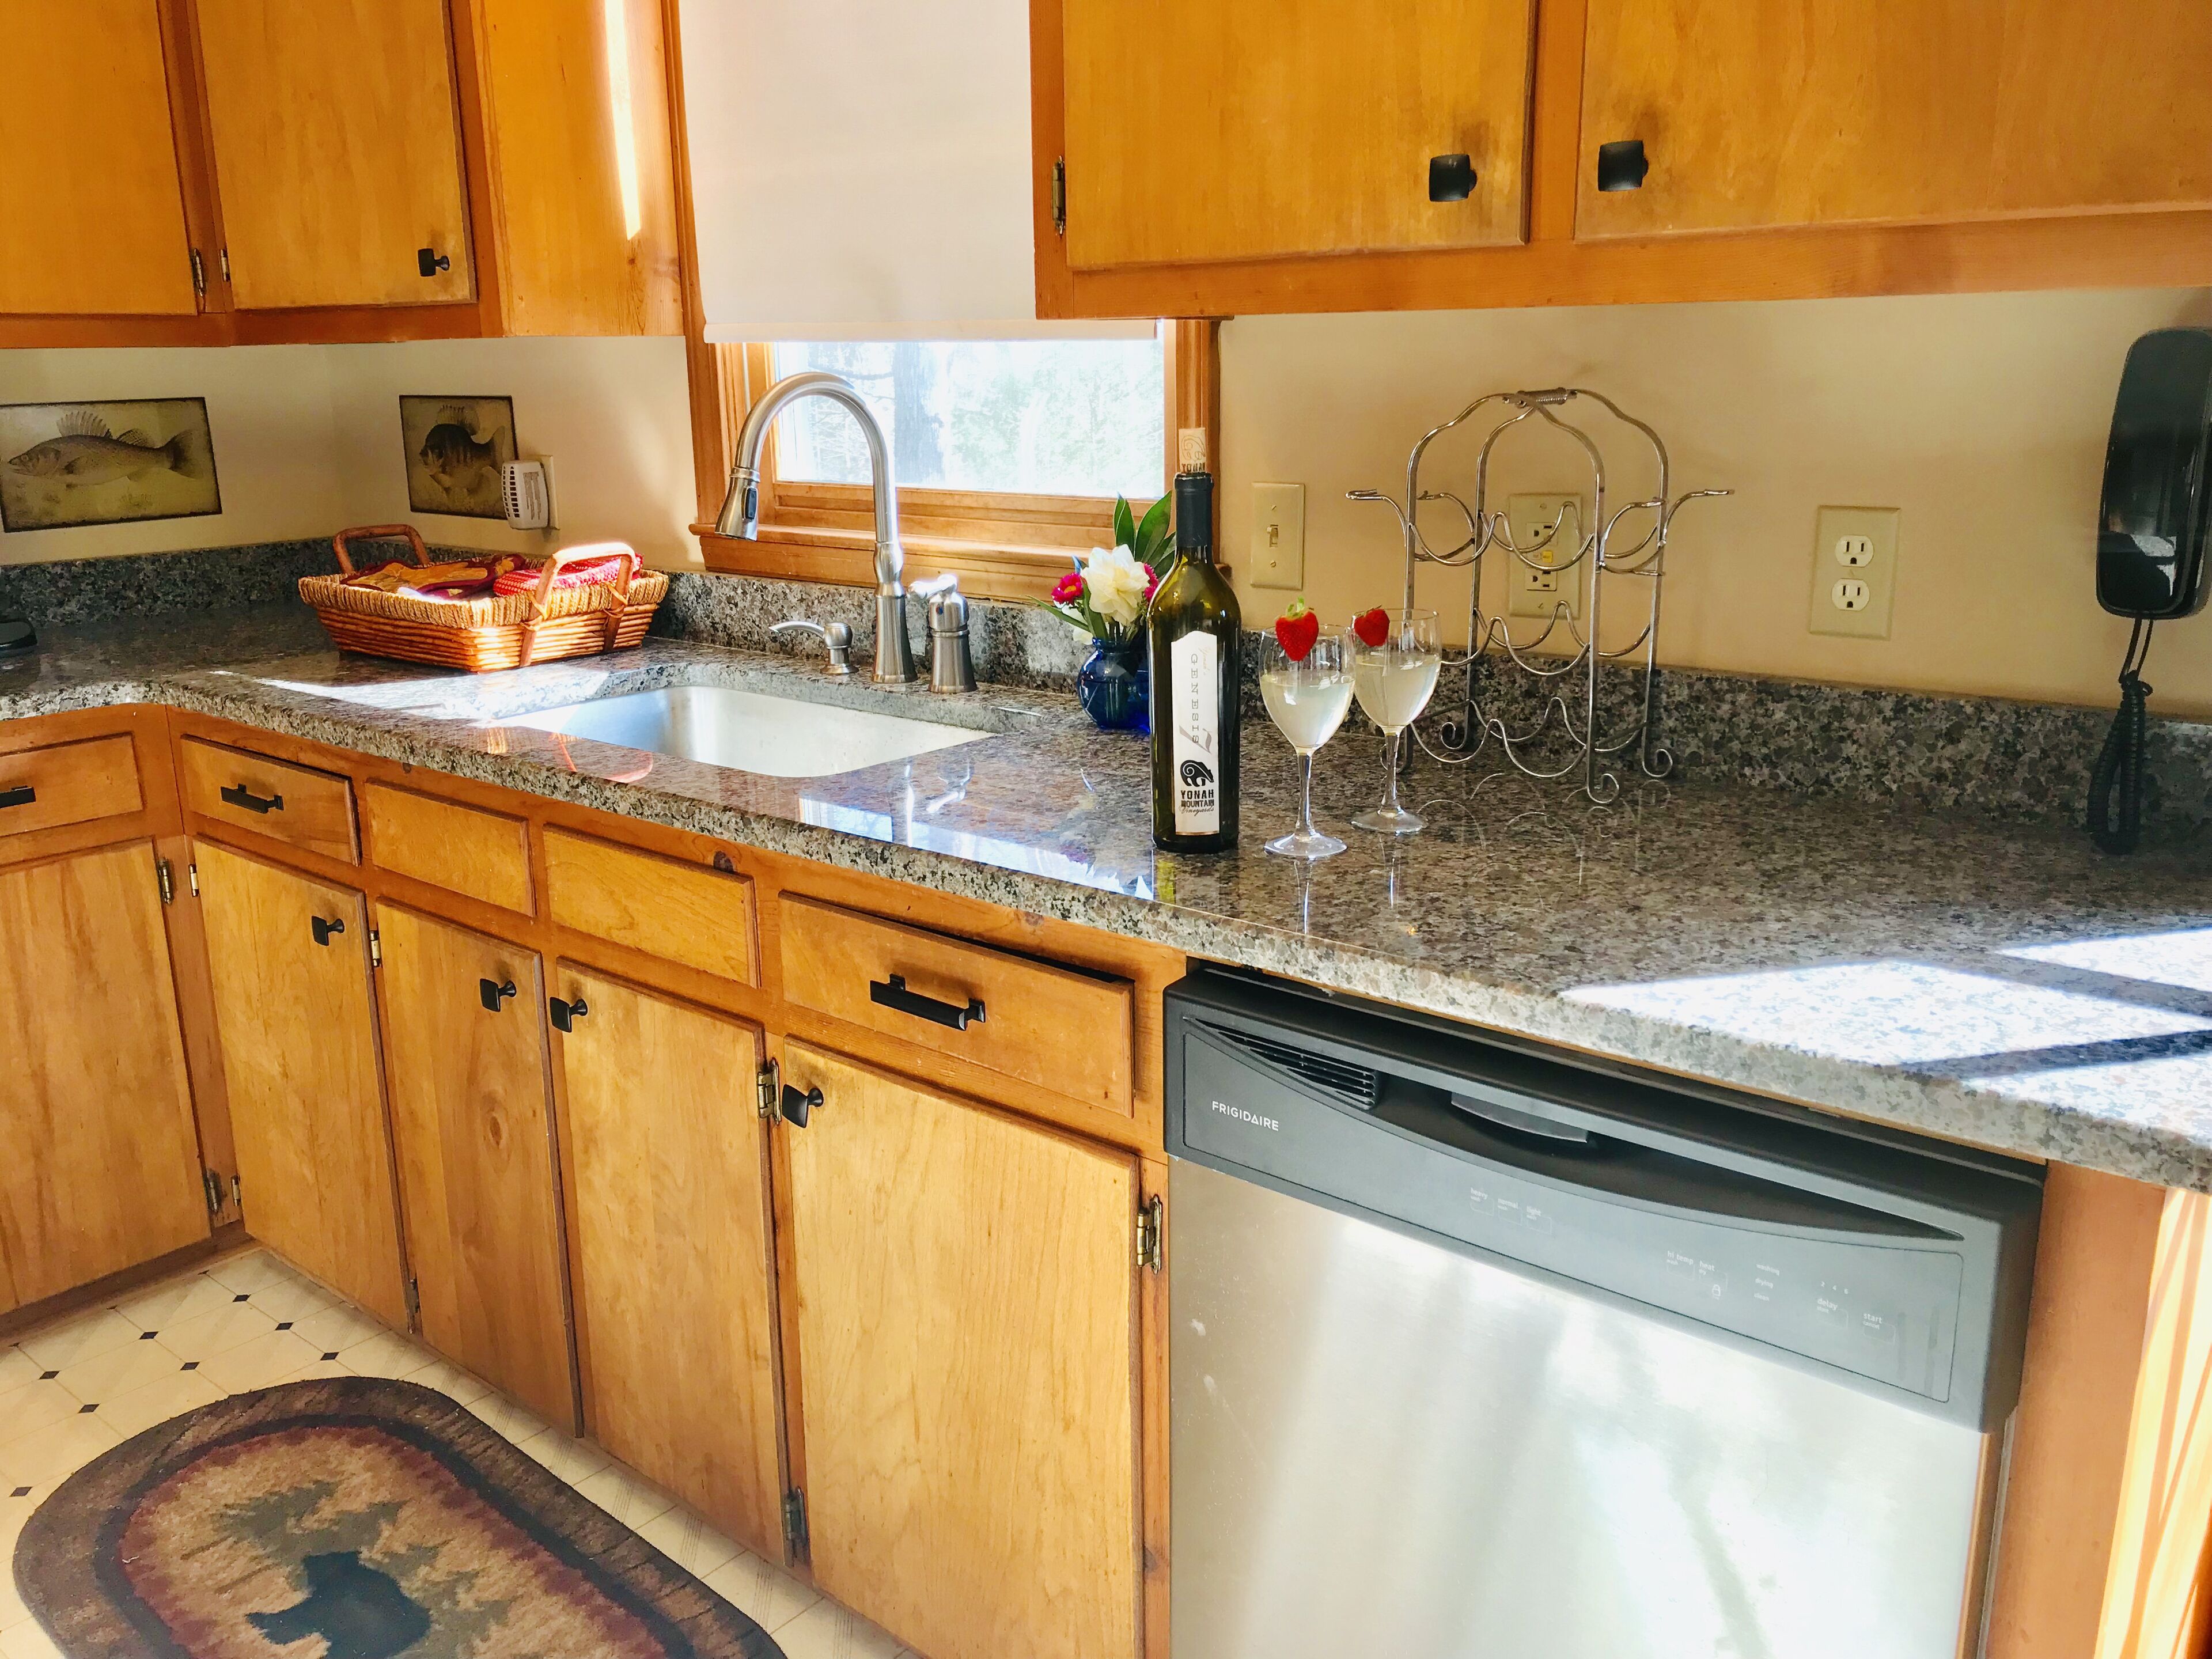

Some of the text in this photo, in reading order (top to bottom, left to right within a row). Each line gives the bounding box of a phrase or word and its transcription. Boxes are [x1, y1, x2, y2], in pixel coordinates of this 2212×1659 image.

[1191, 653, 1199, 743] GENESIS
[1181, 789, 1214, 800] YONAH
[1181, 799, 1214, 807] MOUNTAIN
[1179, 806, 1214, 816] Vineyards
[1212, 1100, 1279, 1131] FRIGIDAIRE
[1676, 1254, 1694, 1266] temp
[1700, 1260, 1715, 1271] heat
[1756, 1264, 1780, 1276] washing
[1755, 1278, 1774, 1289] drying
[1817, 1298, 1838, 1310] delay
[1863, 1313, 1883, 1324] start
